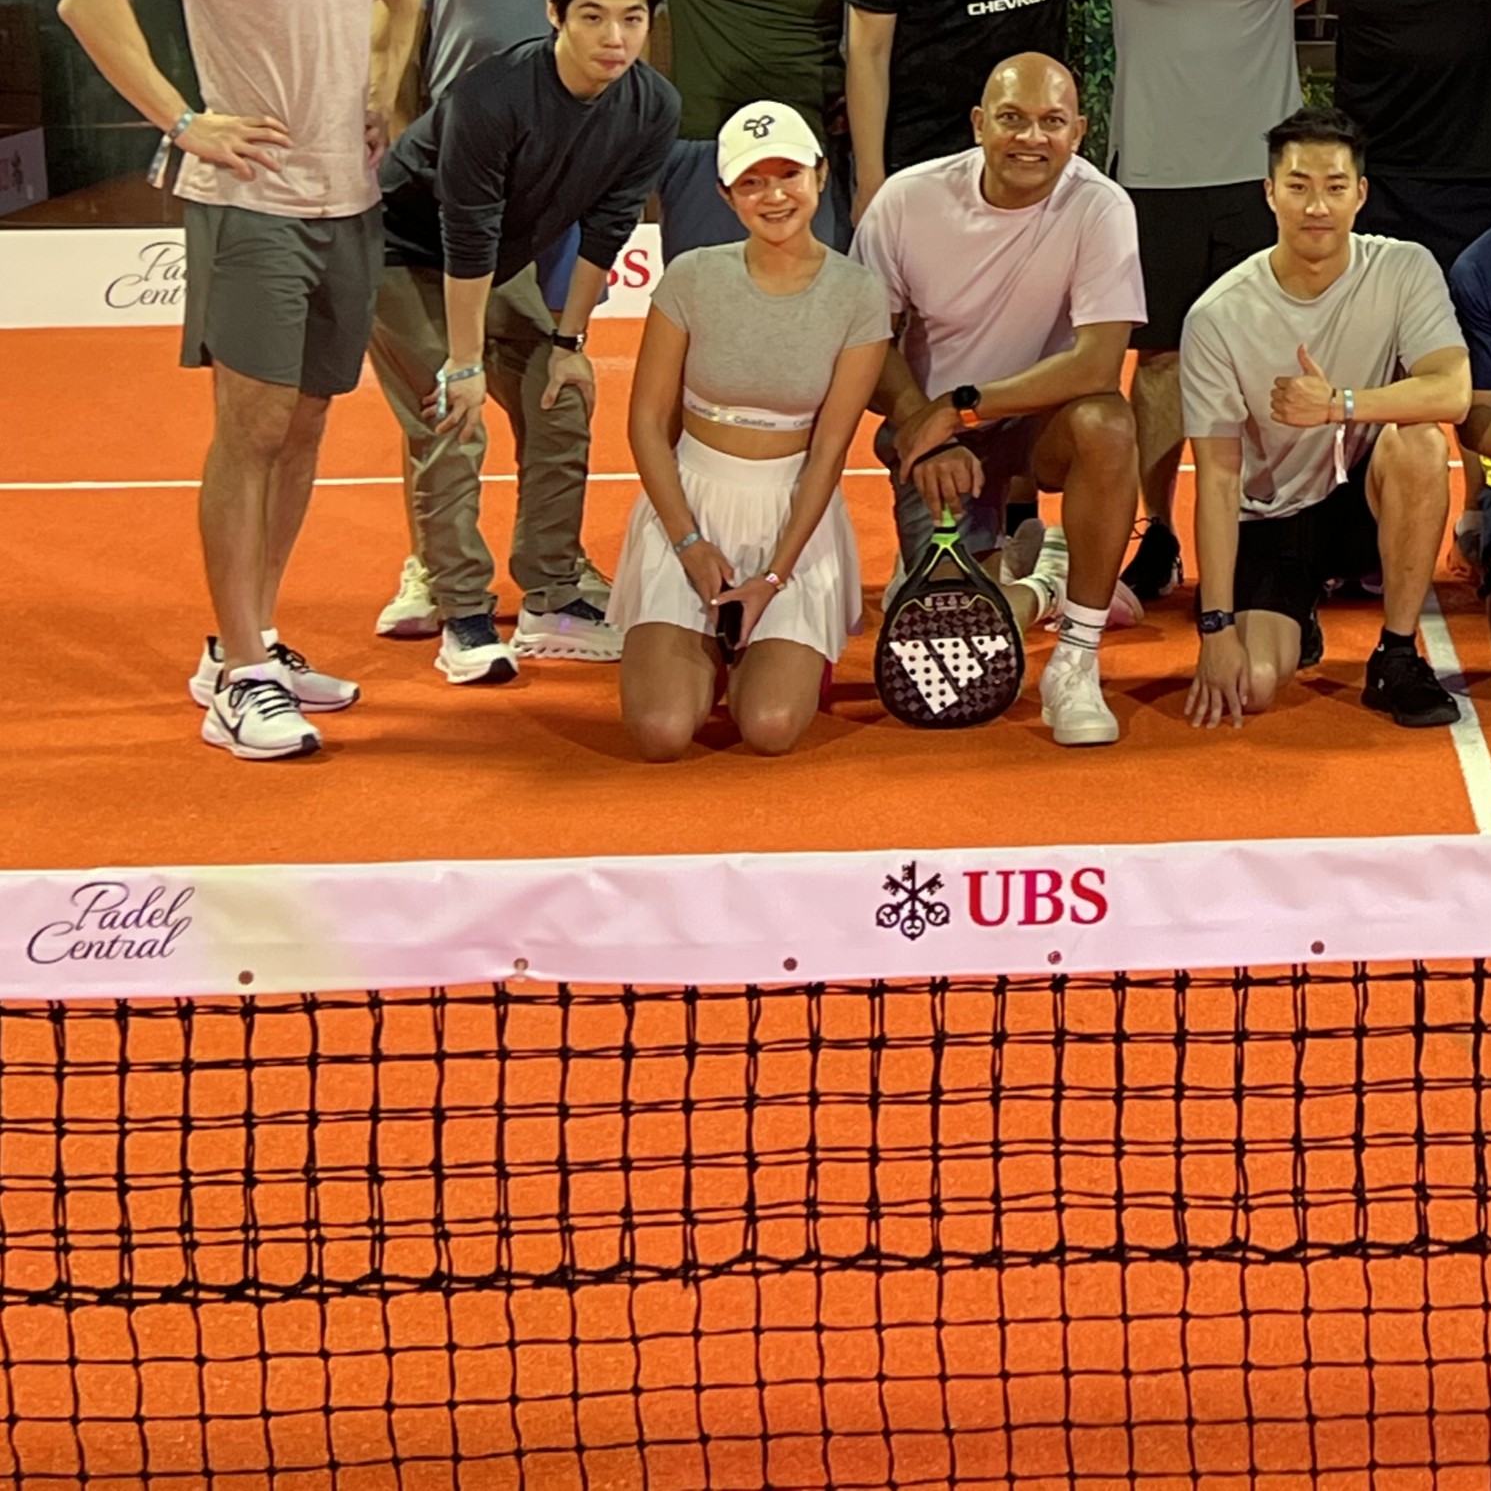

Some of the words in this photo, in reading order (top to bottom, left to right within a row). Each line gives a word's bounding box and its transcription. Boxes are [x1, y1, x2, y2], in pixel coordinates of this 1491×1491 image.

[71, 881, 195, 932] Padel
[962, 867, 1109, 927] UBS
[26, 917, 193, 965] Central
